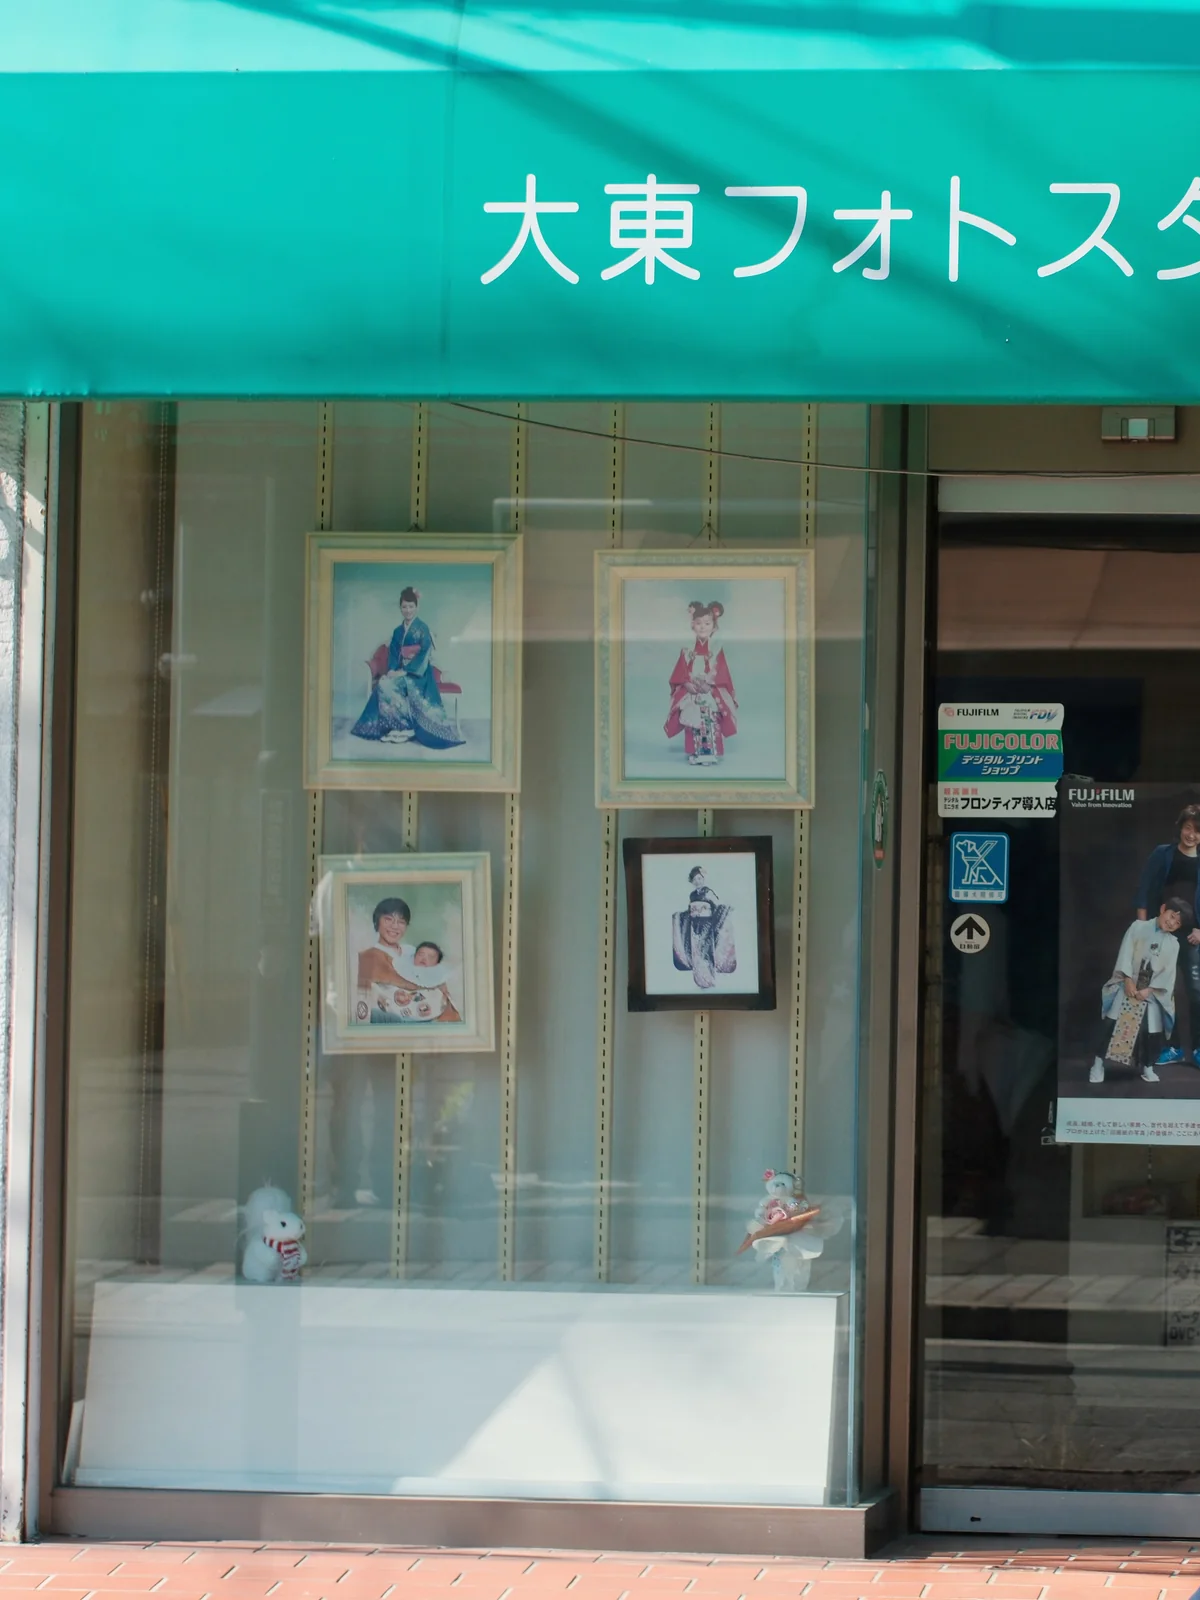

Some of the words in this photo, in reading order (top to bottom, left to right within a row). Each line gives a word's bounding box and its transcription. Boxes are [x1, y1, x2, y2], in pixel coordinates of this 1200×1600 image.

[957, 708, 999, 716] FUJIFILM
[943, 732, 1060, 751] FUJICOLOR
[961, 754, 1005, 765] デジタル
[1005, 754, 1044, 765] プリント
[980, 765, 1021, 775] ショップ
[1068, 788, 1135, 801] FUJIFILM
[960, 796, 1057, 811] フロンティア導入店
